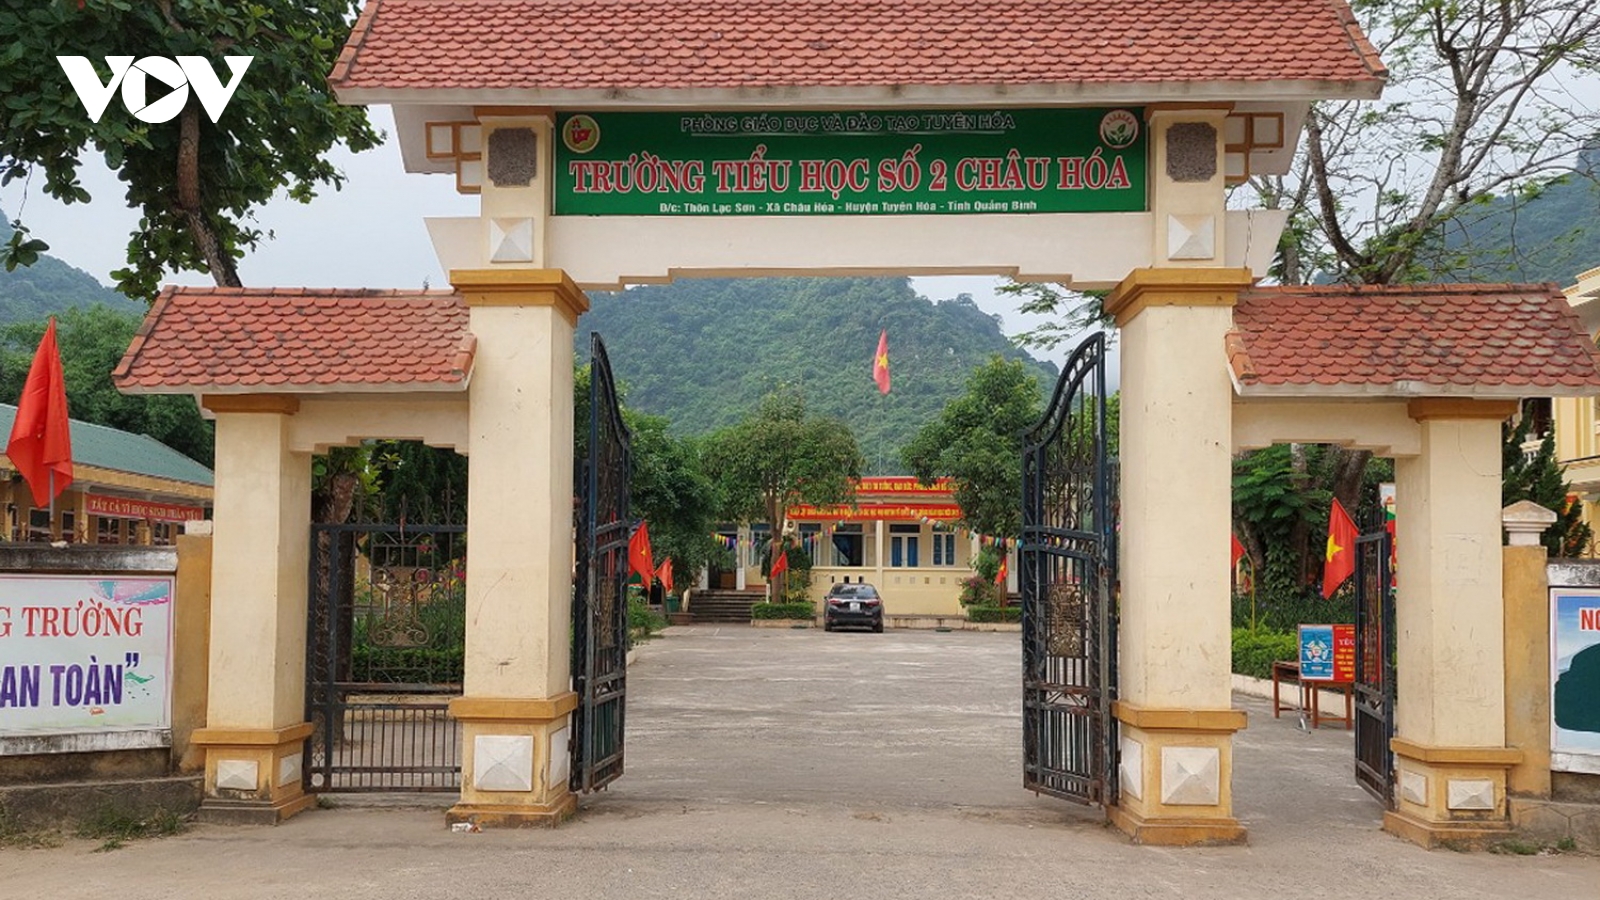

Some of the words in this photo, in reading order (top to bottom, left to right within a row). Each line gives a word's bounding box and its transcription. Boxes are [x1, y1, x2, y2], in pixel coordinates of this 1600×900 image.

[681, 114, 737, 132] PHÒNG
[741, 113, 782, 132] GIÁO
[784, 117, 819, 133] DỤC
[820, 114, 843, 131] VÀ
[846, 112, 882, 131] ĐÀO
[885, 115, 920, 133] TẠO
[922, 112, 975, 130] TUYÊN
[978, 111, 1015, 129] HÓA
[569, 151, 705, 193] TRƯỜNG
[712, 144, 792, 192] TIỂU
[798, 159, 870, 200] HỌC
[878, 143, 922, 192] SỐ
[929, 160, 947, 191] 2
[955, 149, 1050, 190] CHÂU
[1057, 146, 1132, 190] HÓA
[684, 203, 709, 212] Thôn
[712, 203, 731, 214] Lạc
[735, 202, 755, 212] Sơn
[783, 202, 811, 212] Châu
[814, 202, 834, 212] Hóa
[845, 202, 878, 213] Huyện
[882, 202, 912, 213] Tuyên
[916, 202, 936, 211] Hóa
[21, 598, 143, 637] TRƯỜNG
[0, 665, 40, 708] AN
